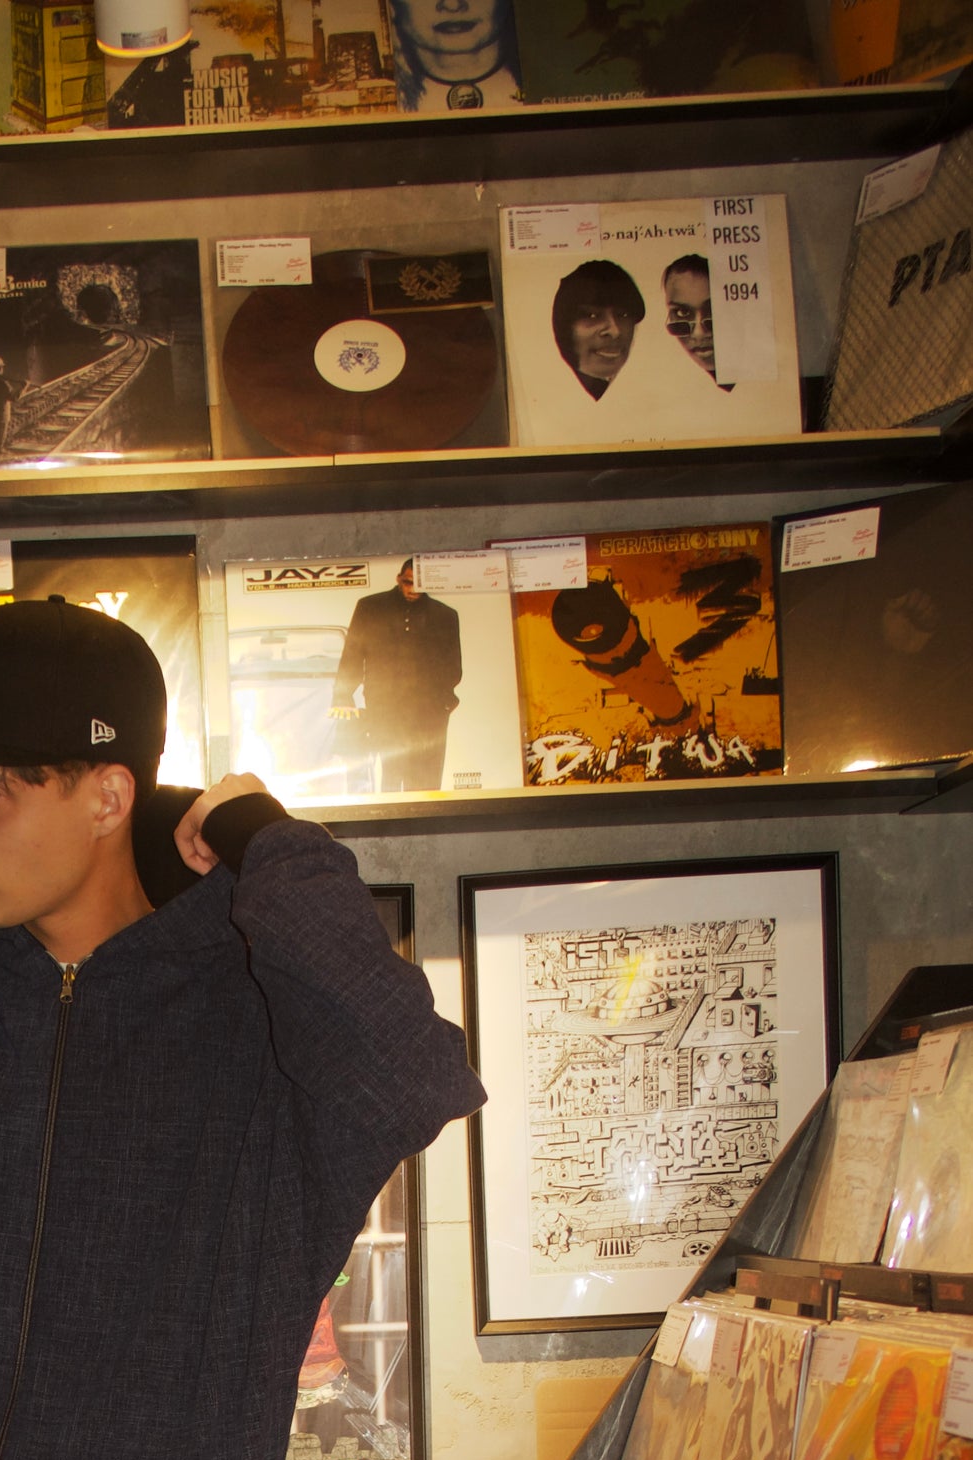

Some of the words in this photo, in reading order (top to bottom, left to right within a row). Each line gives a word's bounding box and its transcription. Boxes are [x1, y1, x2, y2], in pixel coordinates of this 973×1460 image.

[193, 67, 249, 89] MUSIC
[184, 89, 215, 108] FOR
[222, 87, 249, 106] MY
[185, 107, 250, 126] FRIENDS
[713, 198, 755, 216] FIRST
[712, 225, 761, 244] PRESS
[728, 255, 749, 272] US
[723, 283, 759, 301] 1994
[246, 565, 367, 582] JAY-Z
